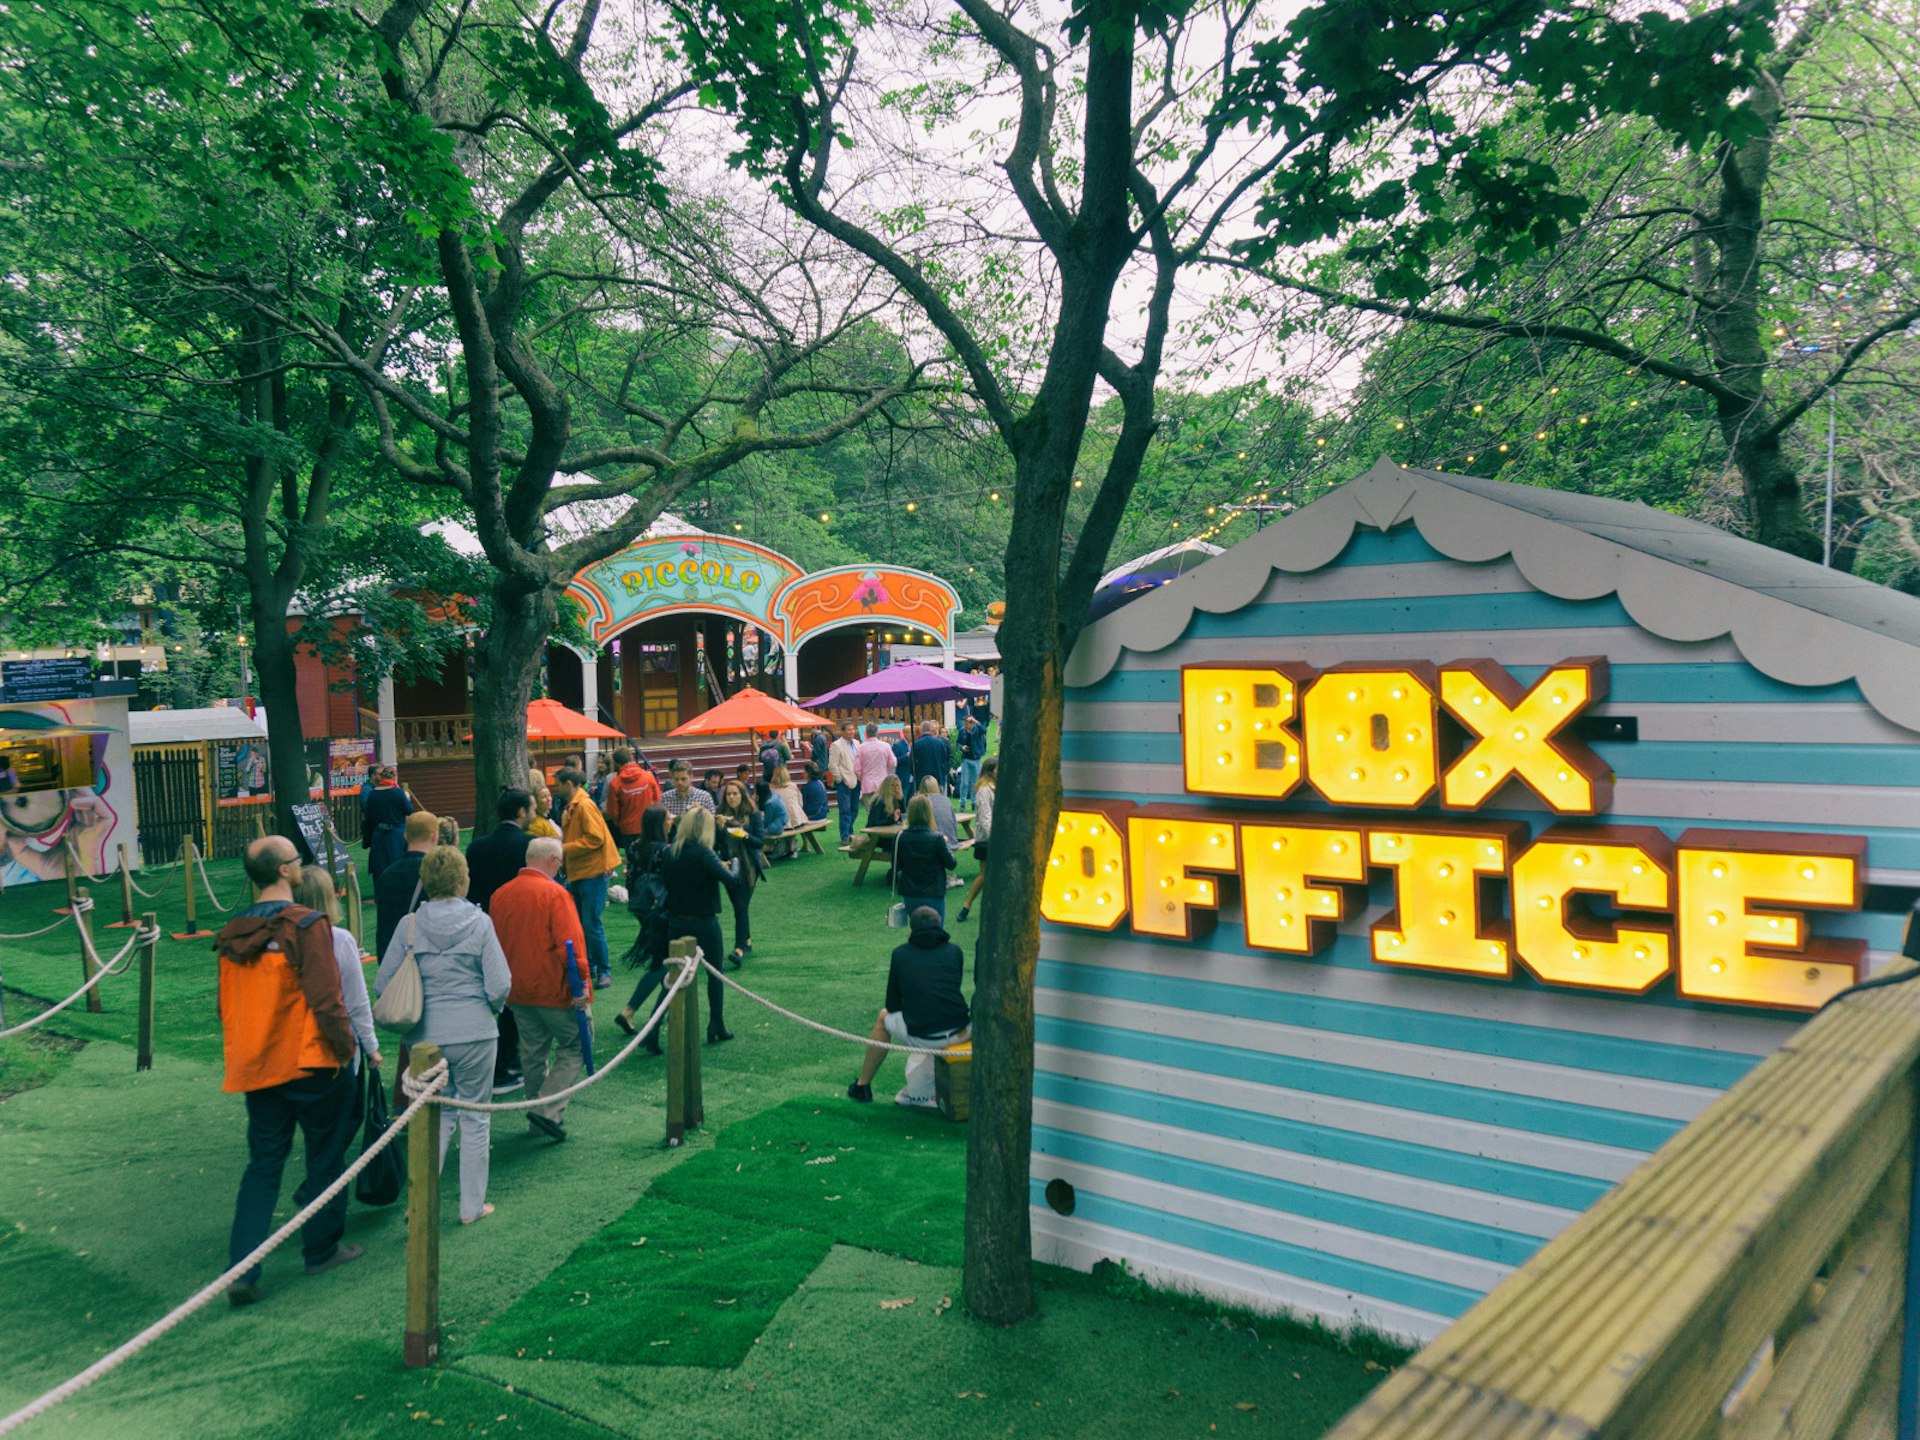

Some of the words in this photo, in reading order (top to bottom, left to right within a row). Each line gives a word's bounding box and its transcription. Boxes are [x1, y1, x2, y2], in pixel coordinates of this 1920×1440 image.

[620, 559, 762, 597] PICCOLO
[1180, 657, 1610, 814] BOX
[1040, 799, 1867, 1009] OFFICE
